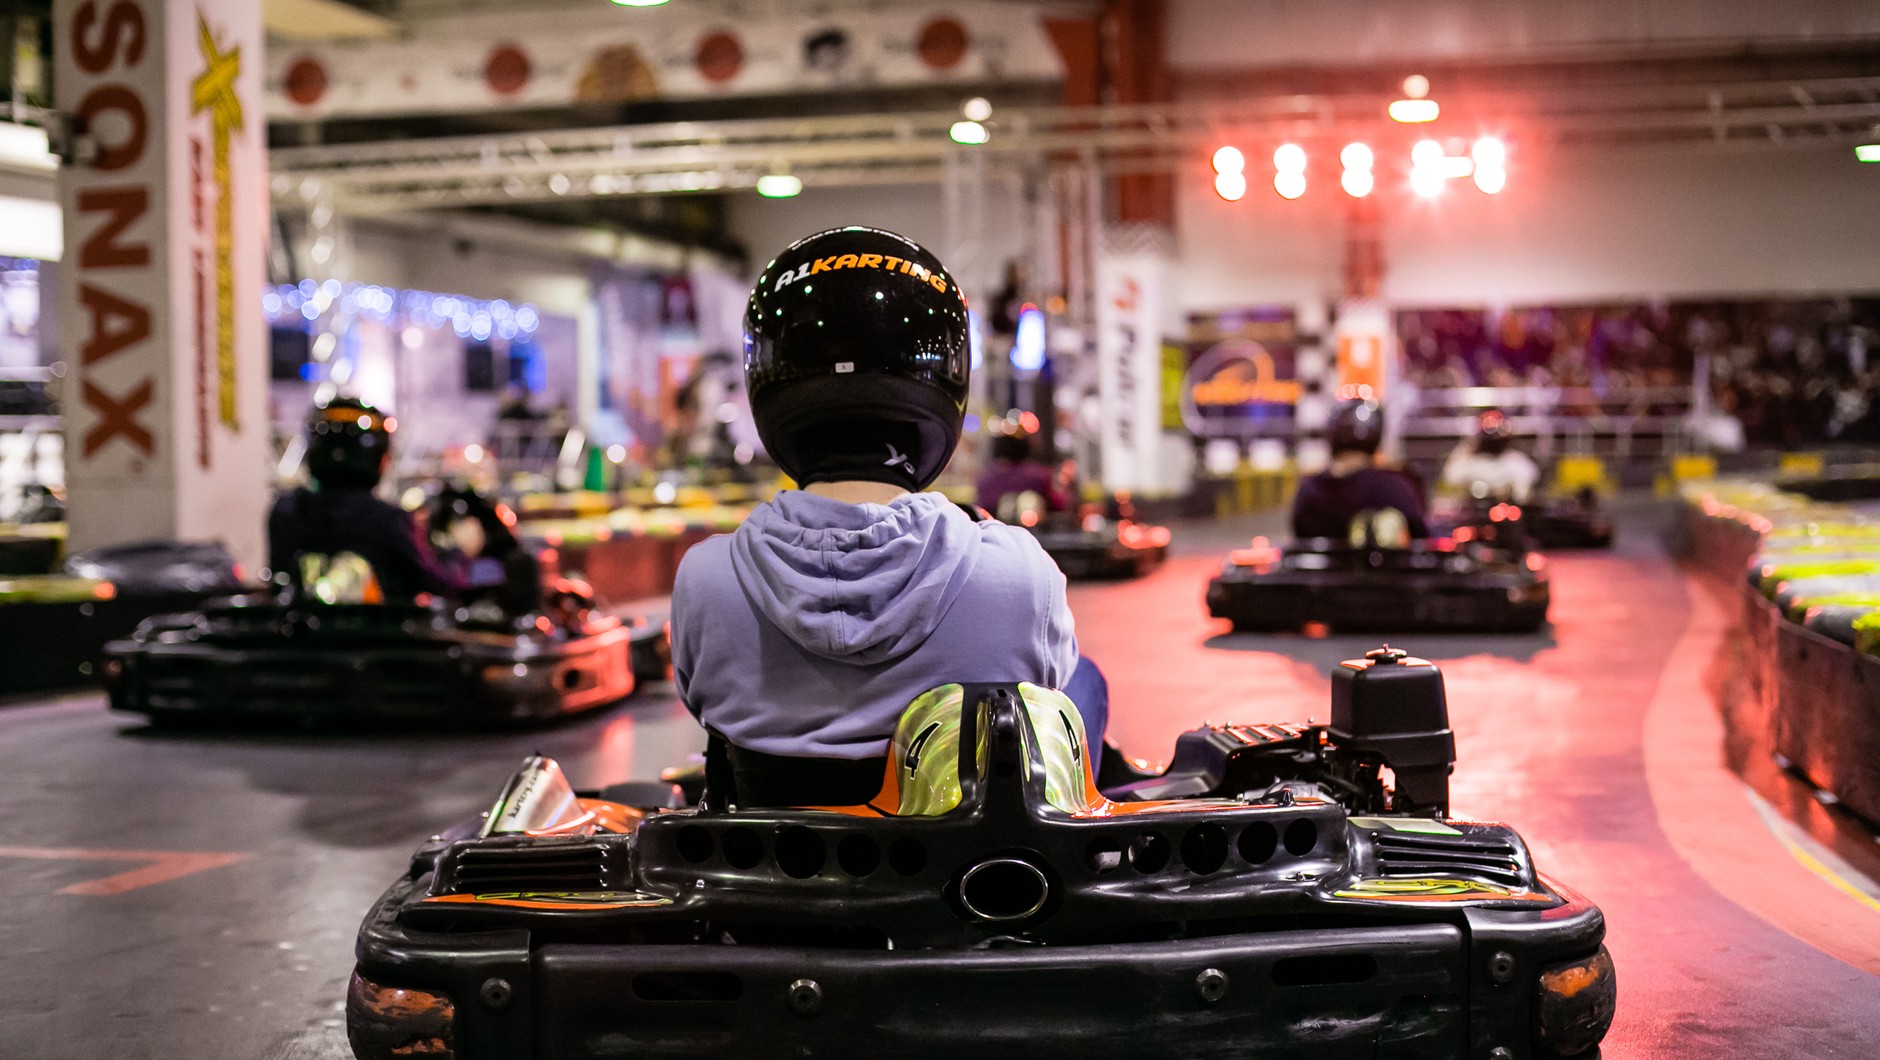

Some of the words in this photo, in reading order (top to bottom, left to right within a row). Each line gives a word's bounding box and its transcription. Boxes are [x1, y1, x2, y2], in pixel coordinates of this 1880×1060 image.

[71, 0, 156, 458] SONAX
[774, 253, 948, 294] A1KARTING
[905, 721, 943, 781] 4
[1058, 709, 1081, 768] 4
